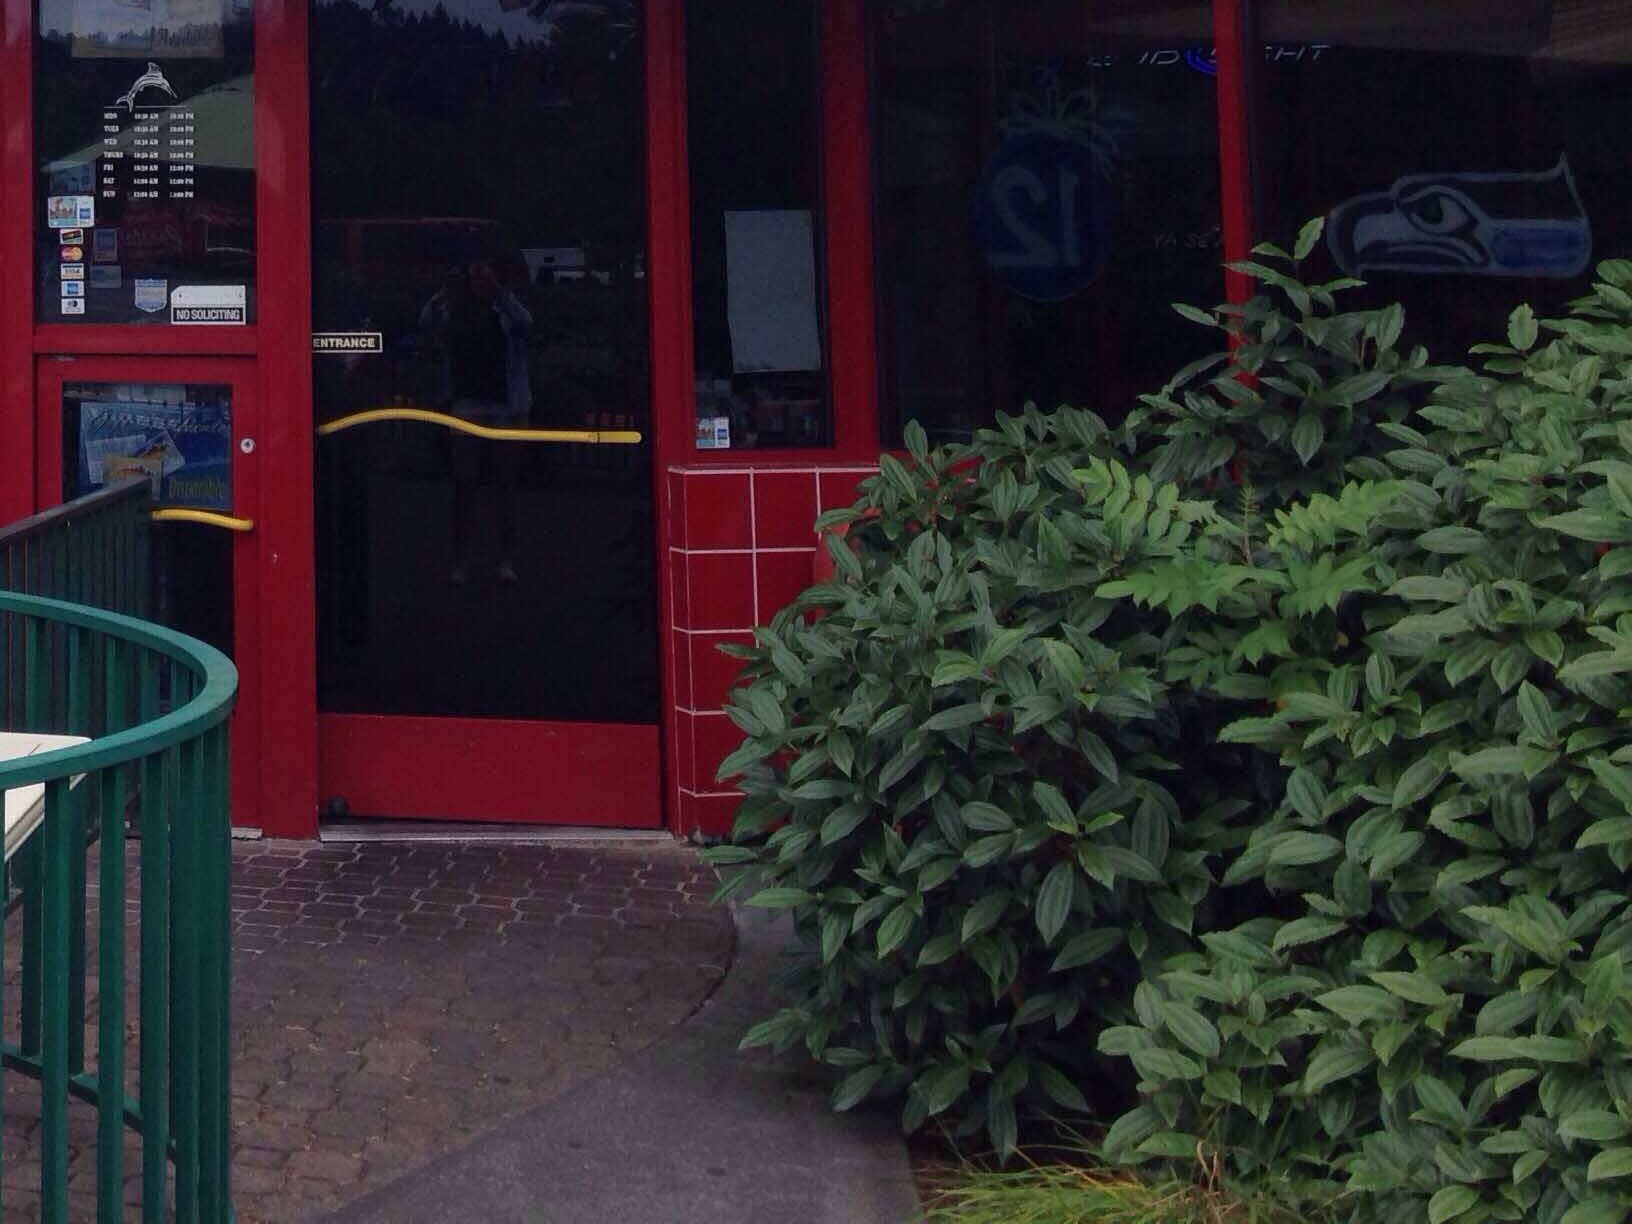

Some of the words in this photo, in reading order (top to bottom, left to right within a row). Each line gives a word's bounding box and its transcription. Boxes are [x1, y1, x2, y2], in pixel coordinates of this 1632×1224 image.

[185, 113, 194, 121] PM
[185, 125, 194, 133] PM
[185, 138, 194, 146] PM
[185, 151, 194, 159] PM
[185, 164, 194, 172] PM
[185, 177, 194, 185] PM
[176, 309, 190, 321] NO
[191, 309, 240, 321] SOLICITING
[313, 338, 375, 348] ENTRANCE
